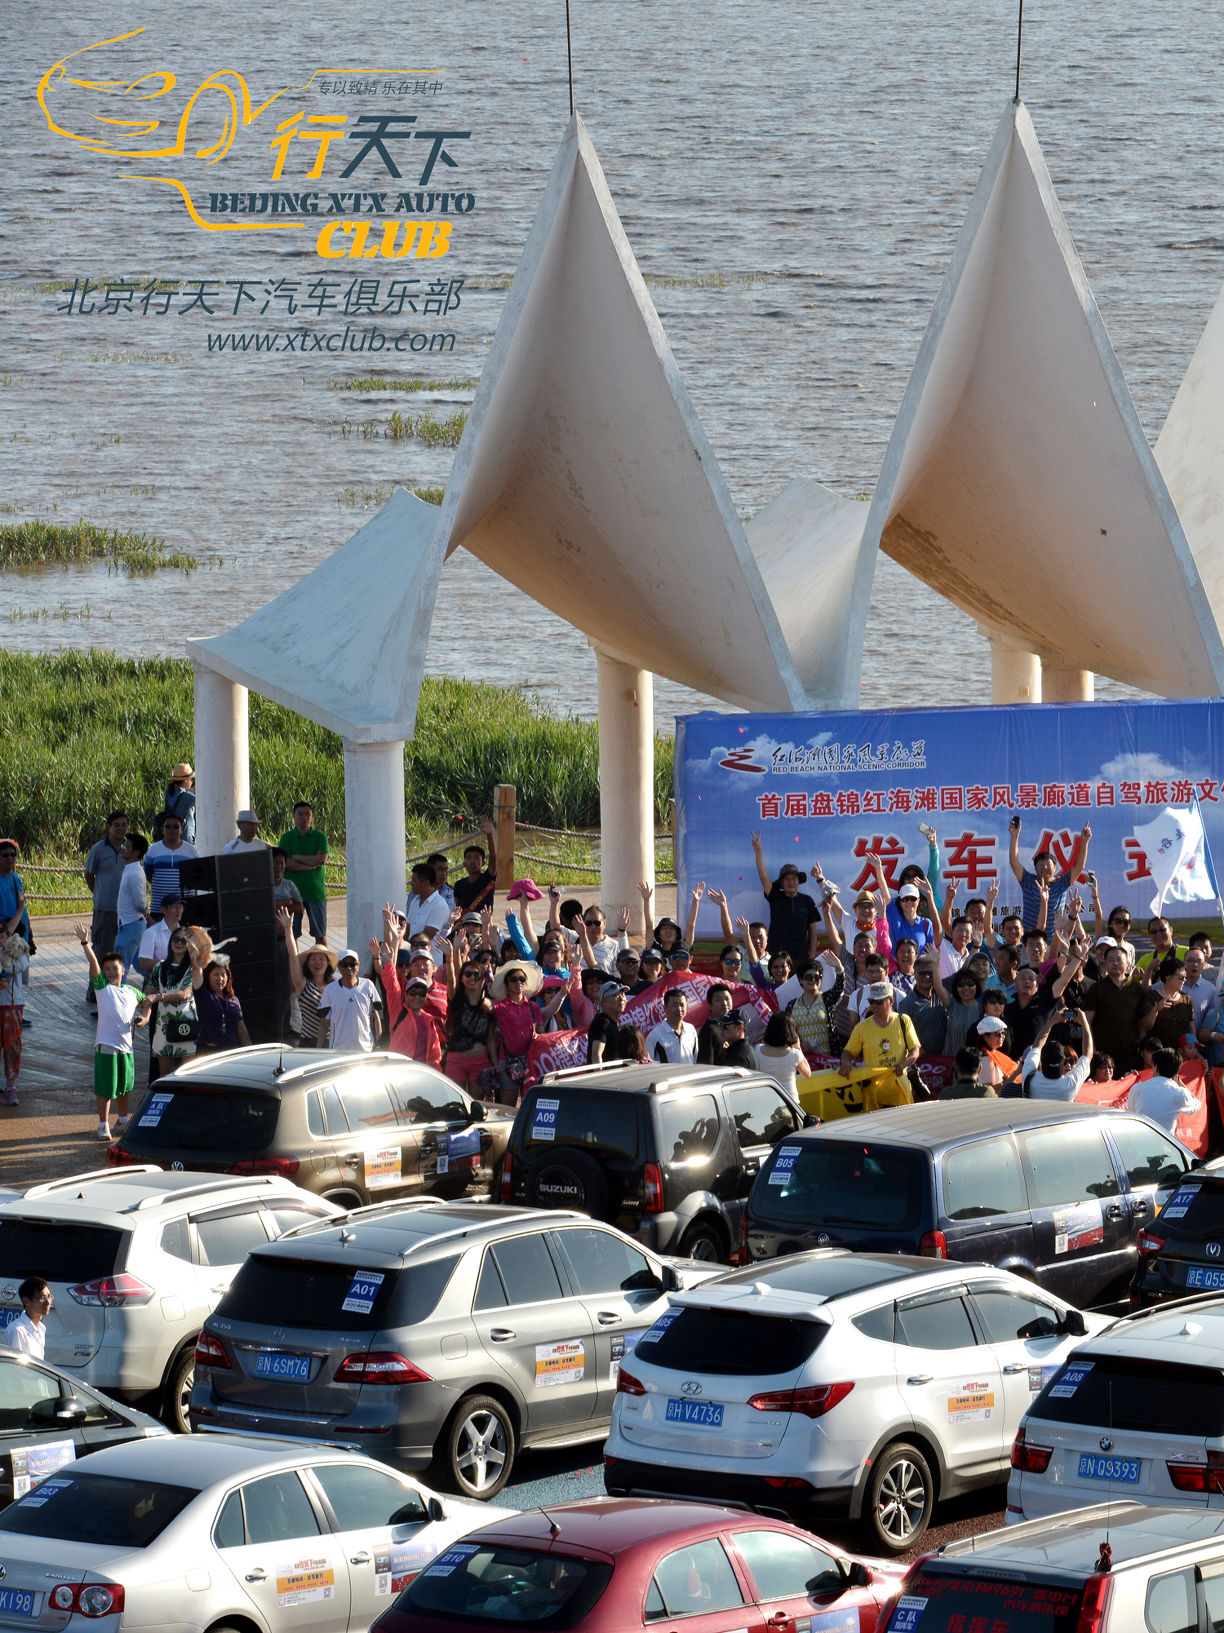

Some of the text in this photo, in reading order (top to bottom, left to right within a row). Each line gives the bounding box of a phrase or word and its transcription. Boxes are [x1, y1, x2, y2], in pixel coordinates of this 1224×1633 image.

[790, 765, 816, 773] BEACH
[817, 764, 856, 772] NATIONAL
[886, 760, 926, 769] CORRIDOR
[536, 1112, 555, 1123] A09
[776, 1158, 794, 1168] B05
[539, 1184, 578, 1194] SUZUKI
[1173, 1194, 1194, 1204] A17
[350, 1283, 376, 1296] A01
[1062, 1372, 1084, 1382] A08
[440, 1553, 466, 1563] B10
[897, 1610, 916, 1622] C 队
